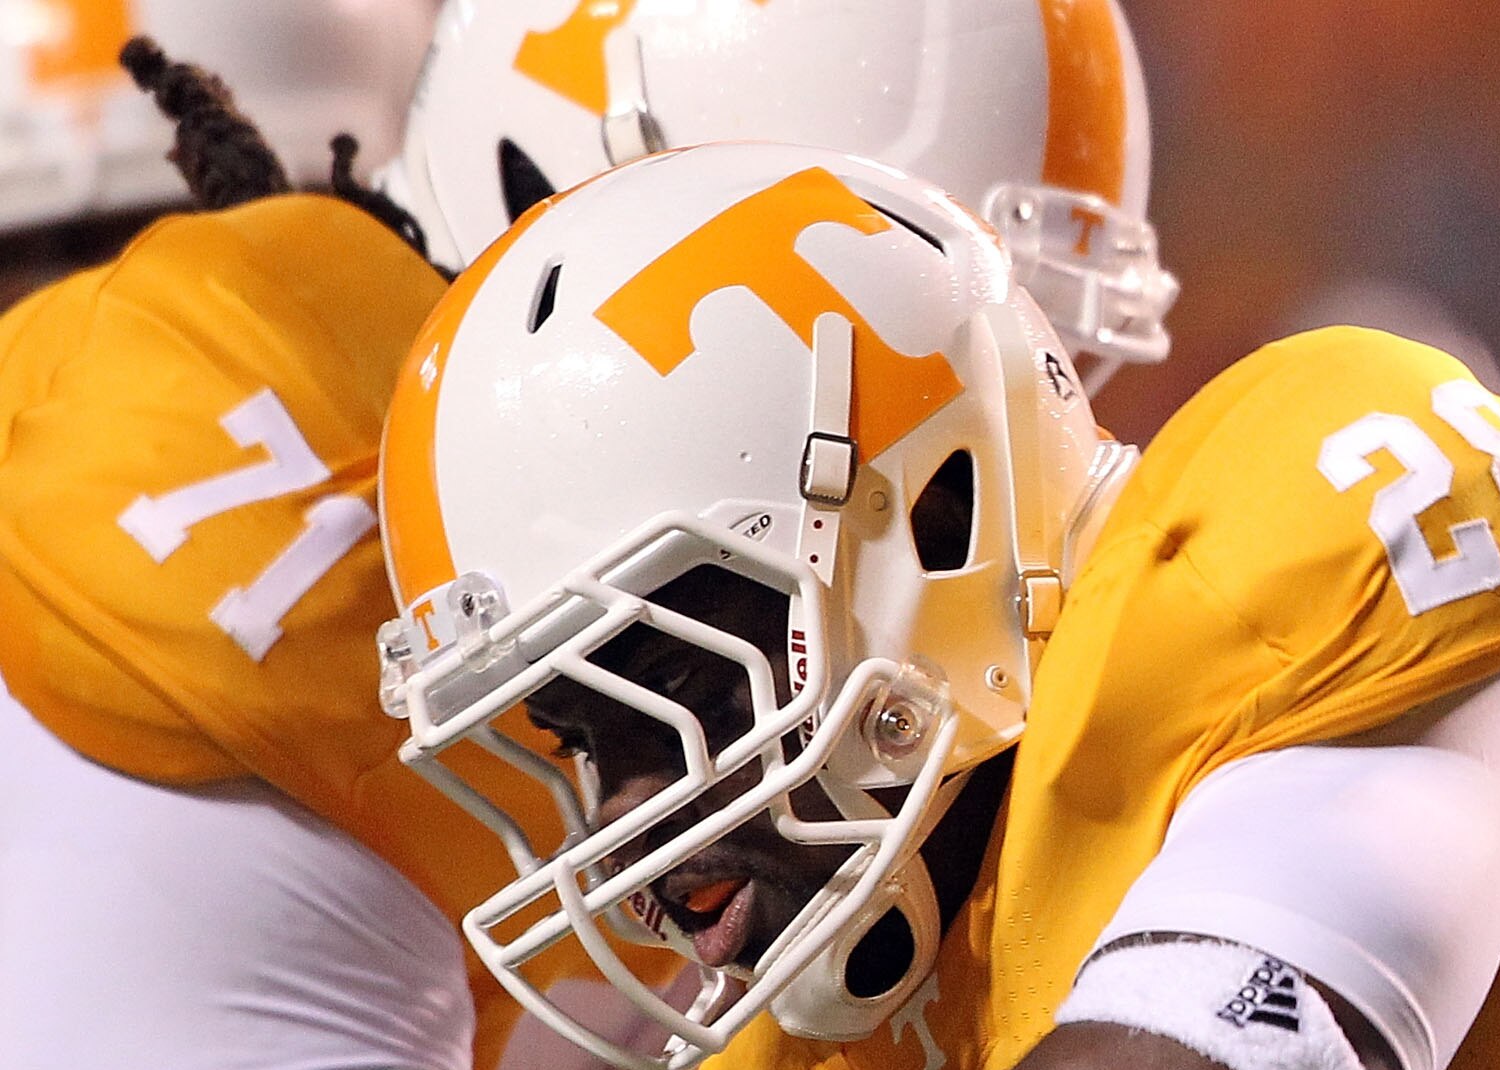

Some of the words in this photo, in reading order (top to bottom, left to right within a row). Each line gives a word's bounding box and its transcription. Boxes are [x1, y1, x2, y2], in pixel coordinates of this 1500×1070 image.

[1071, 207, 1105, 256] T
[594, 167, 965, 464] T
[117, 389, 377, 661] 71
[412, 599, 440, 651] T
